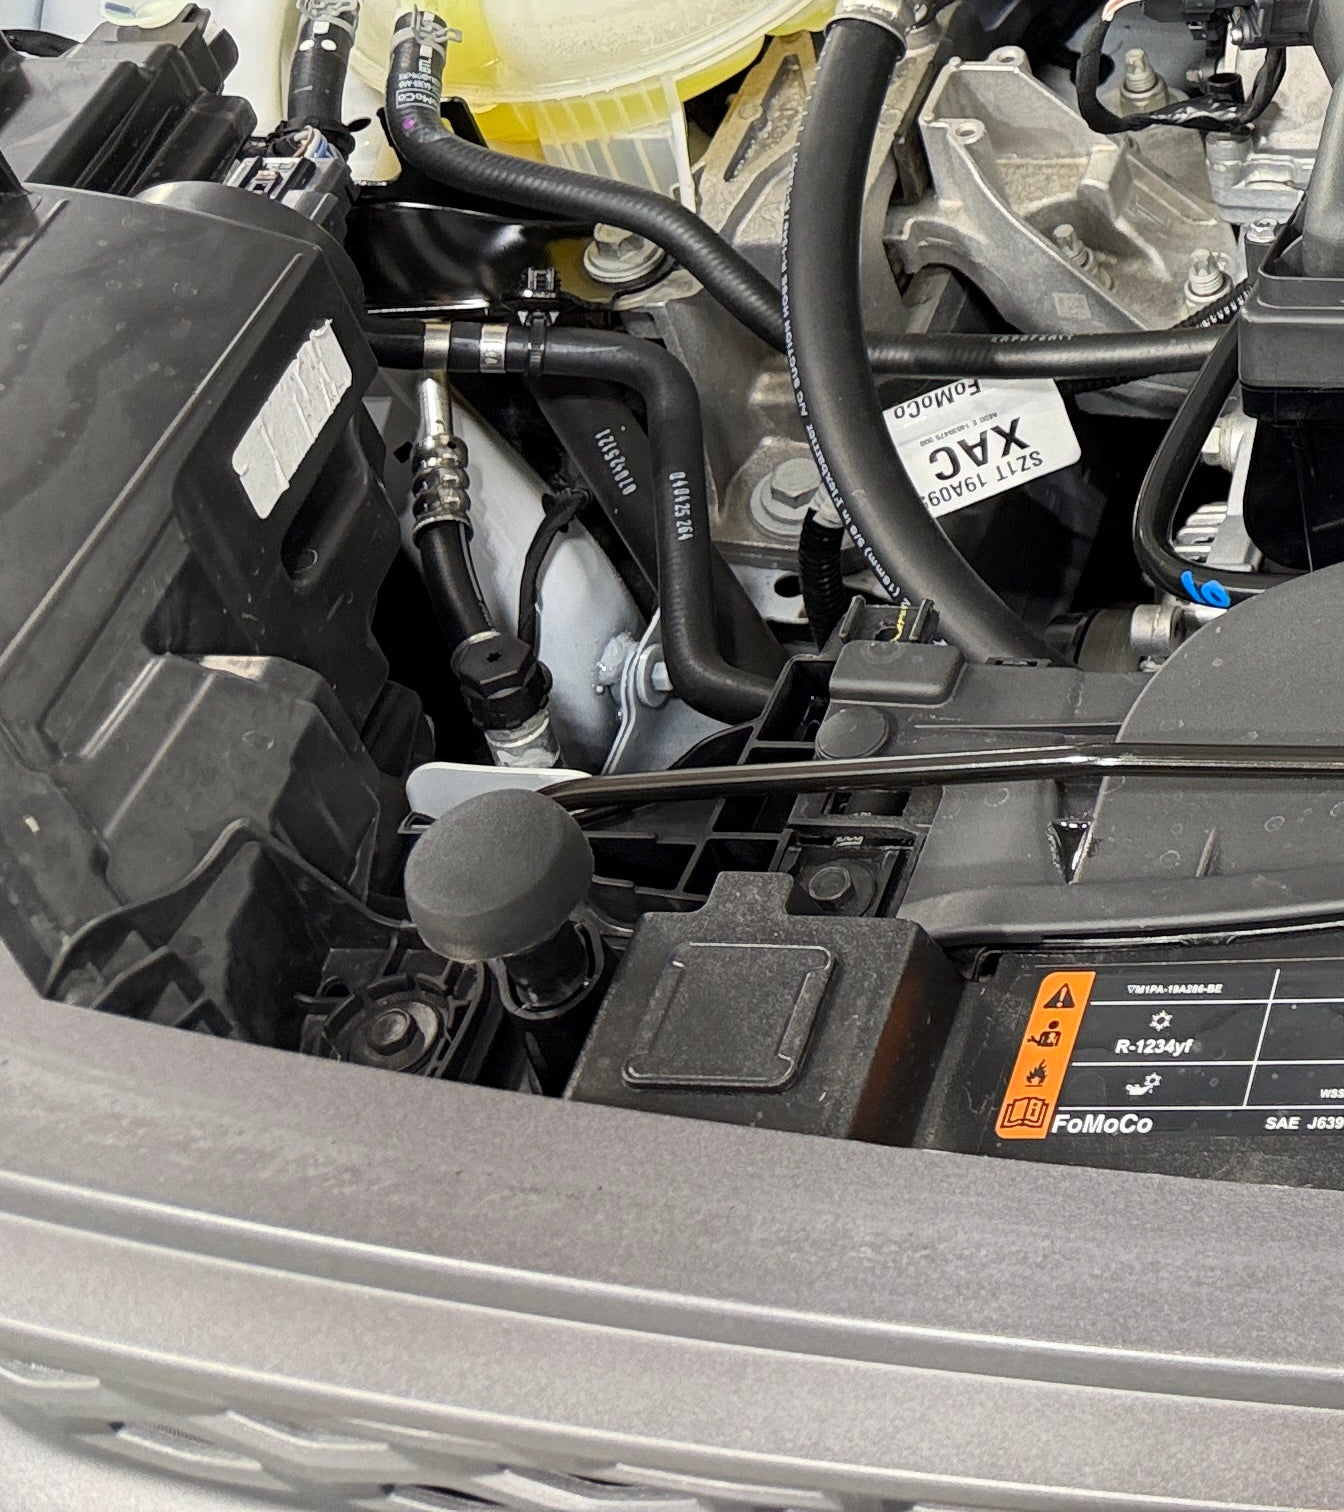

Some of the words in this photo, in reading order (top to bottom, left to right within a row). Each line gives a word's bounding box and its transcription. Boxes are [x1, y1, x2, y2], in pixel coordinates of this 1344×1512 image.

[894, 379, 982, 419] FoMoCo
[929, 417, 1031, 481] XAC
[996, 450, 1043, 482] SZ1T
[1115, 1038, 1194, 1057] R-1234yf
[1052, 1113, 1154, 1134] FoMoCo
[1265, 1116, 1300, 1131] SAE
